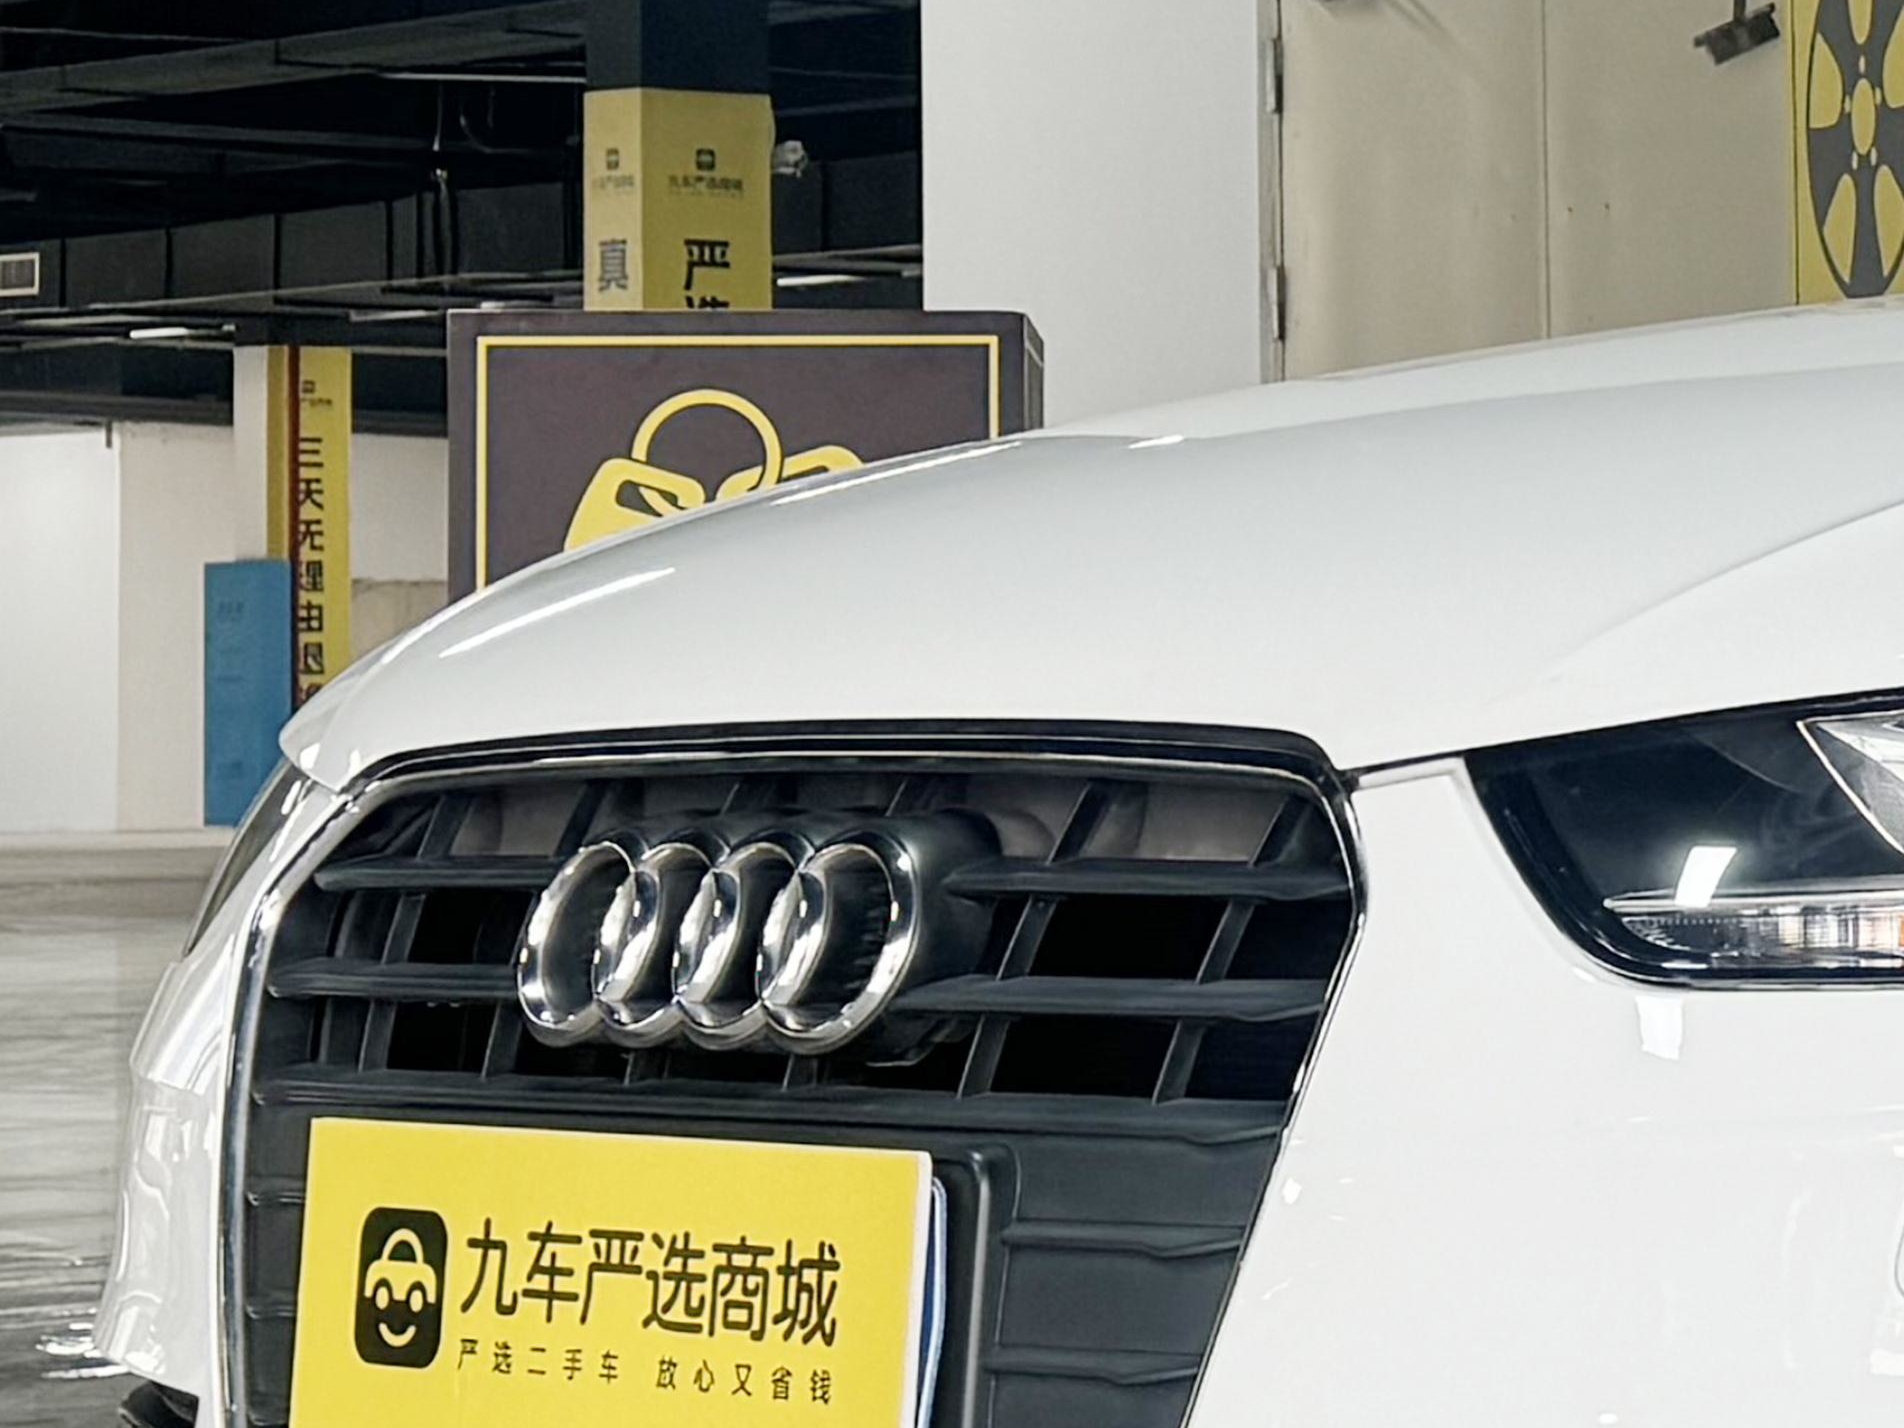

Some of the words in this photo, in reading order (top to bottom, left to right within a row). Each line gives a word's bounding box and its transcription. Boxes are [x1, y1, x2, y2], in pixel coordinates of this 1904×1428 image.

[683, 237, 731, 310] 严
[460, 1218, 840, 1352] 九车严选商城
[457, 1338, 620, 1385] 严选二手车
[655, 1357, 832, 1406] 放心又省钱
